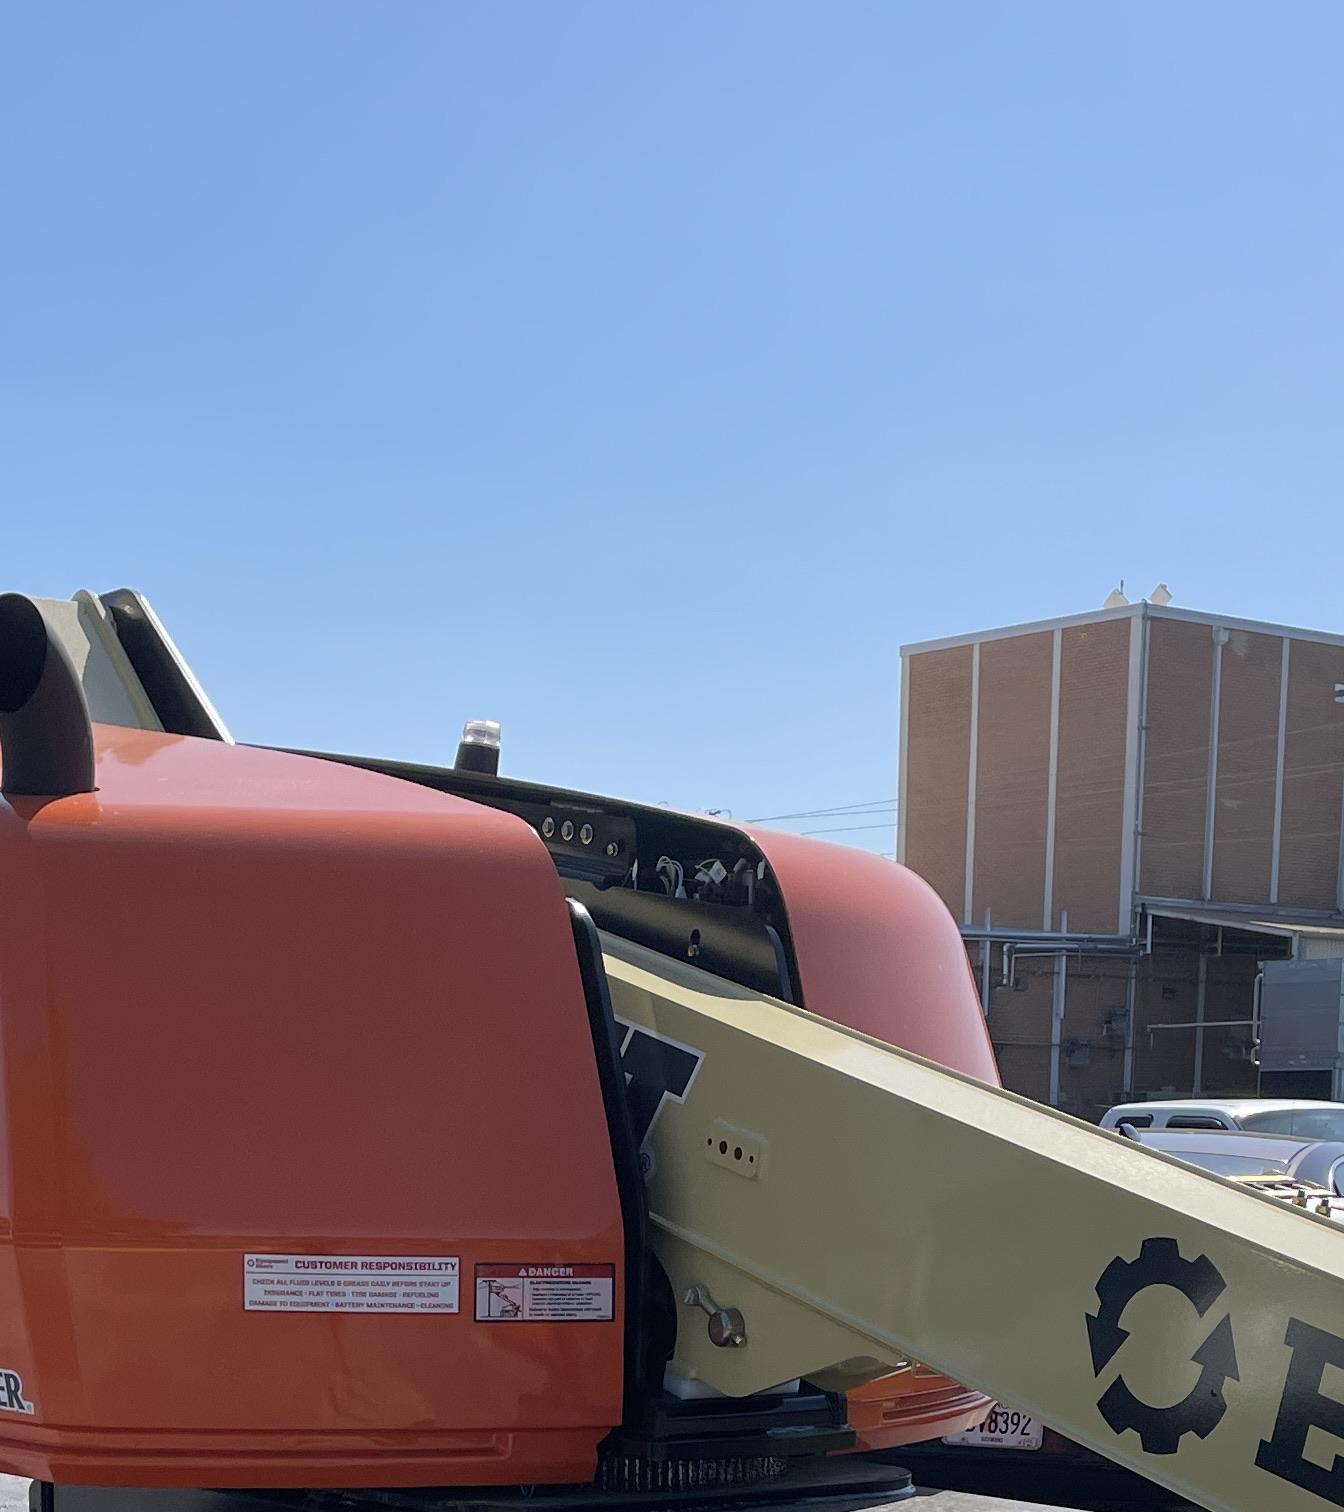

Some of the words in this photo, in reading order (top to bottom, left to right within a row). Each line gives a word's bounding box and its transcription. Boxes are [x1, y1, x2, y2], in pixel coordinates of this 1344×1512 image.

[294, 1259, 359, 1271] CUSTOMER
[360, 1260, 457, 1272] RESPONSIBILITY
[528, 1267, 574, 1277] DANGER
